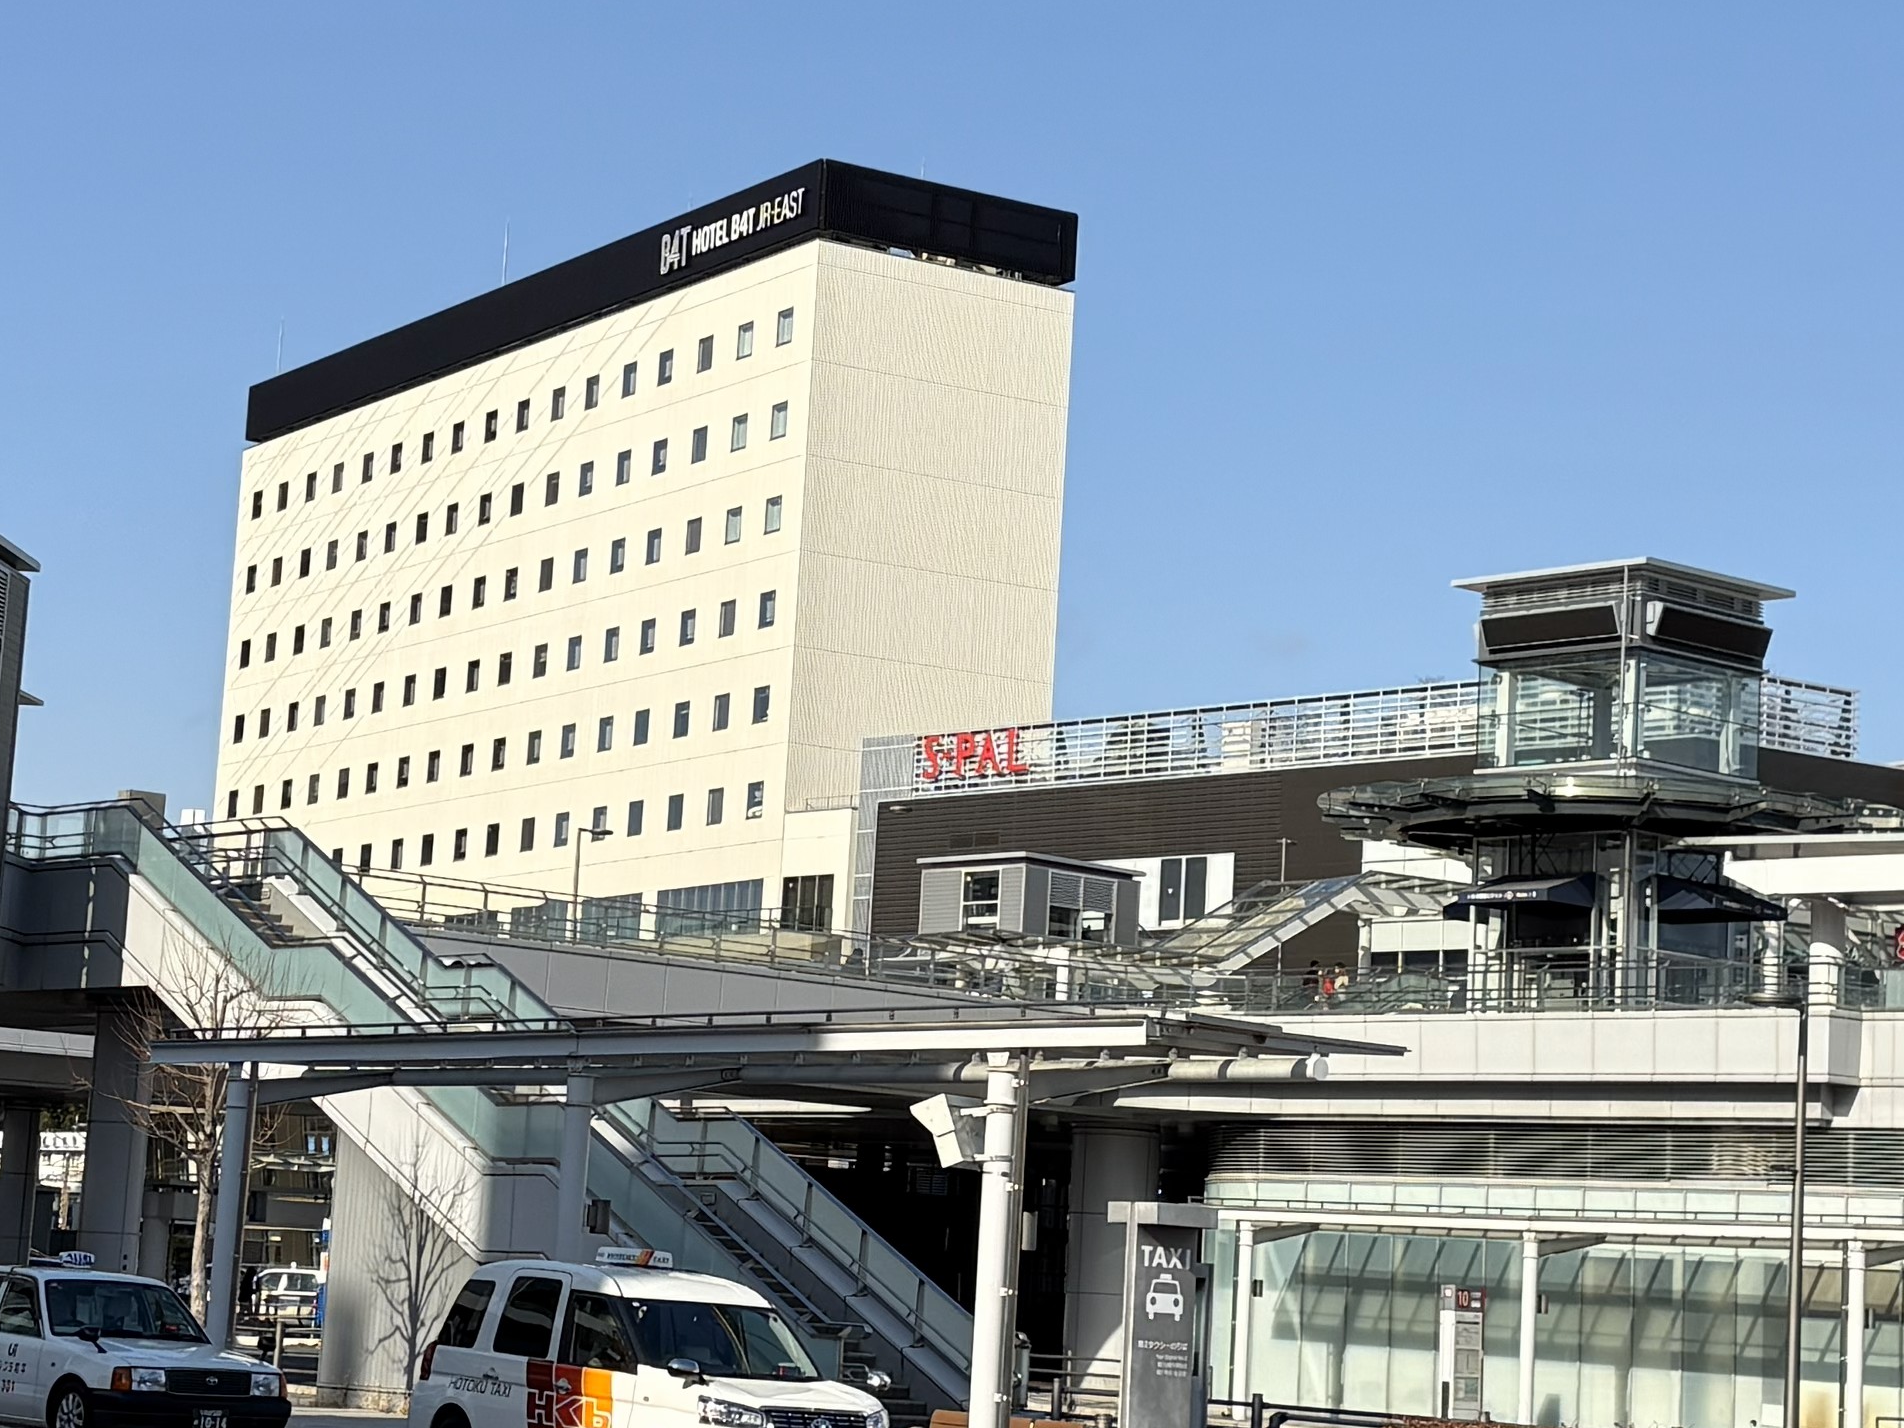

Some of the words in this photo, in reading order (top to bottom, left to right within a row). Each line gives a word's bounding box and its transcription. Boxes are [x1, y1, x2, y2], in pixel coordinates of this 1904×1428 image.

[692, 218, 729, 256] HOTEL
[730, 207, 756, 241] B4T
[756, 187, 805, 231] JR-EAST
[922, 727, 1030, 779] S-PAL
[1141, 1245, 1191, 1270] TAXI
[1458, 1291, 1469, 1308] 10
[448, 1375, 489, 1395] HOTOKU
[490, 1380, 511, 1398] TAXI
